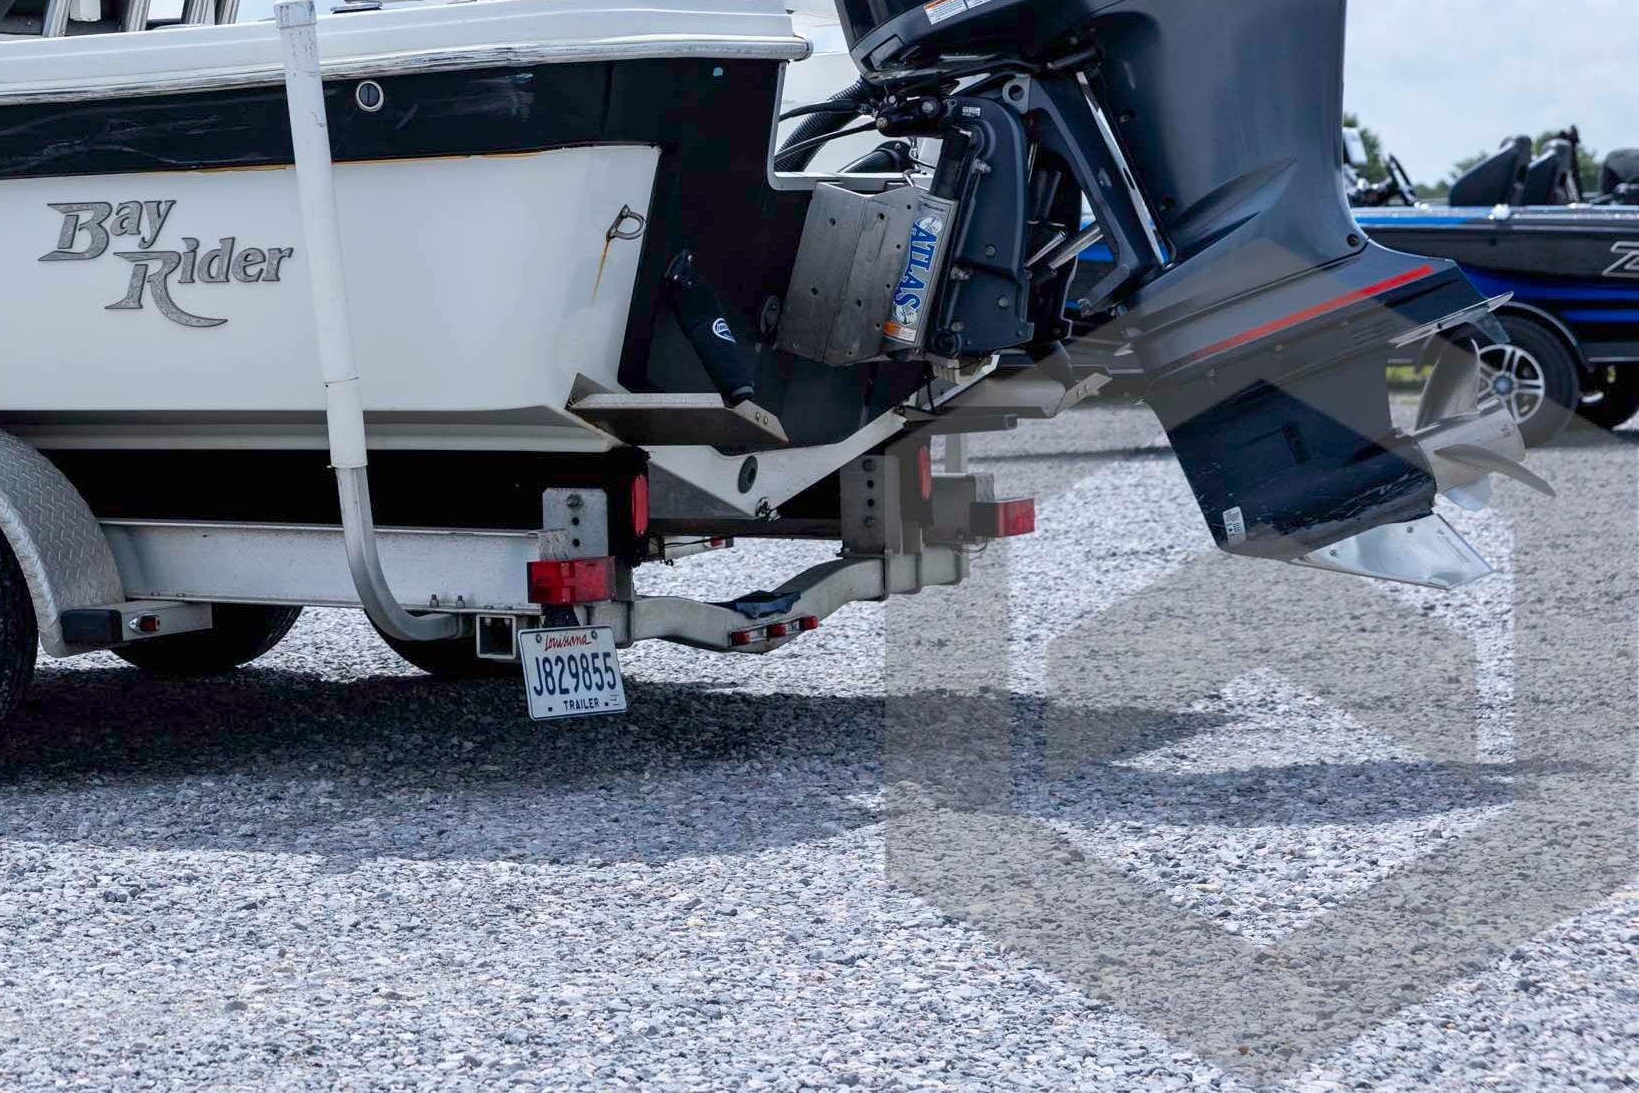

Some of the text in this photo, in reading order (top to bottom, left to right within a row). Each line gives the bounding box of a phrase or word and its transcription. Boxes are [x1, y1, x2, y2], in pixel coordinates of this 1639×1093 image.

[37, 200, 177, 262] Bay
[104, 236, 294, 328] Rider
[893, 222, 938, 311] ATLAS
[544, 633, 593, 652] Louisiana
[533, 651, 617, 697] J829855
[563, 697, 600, 712] TRAILER
